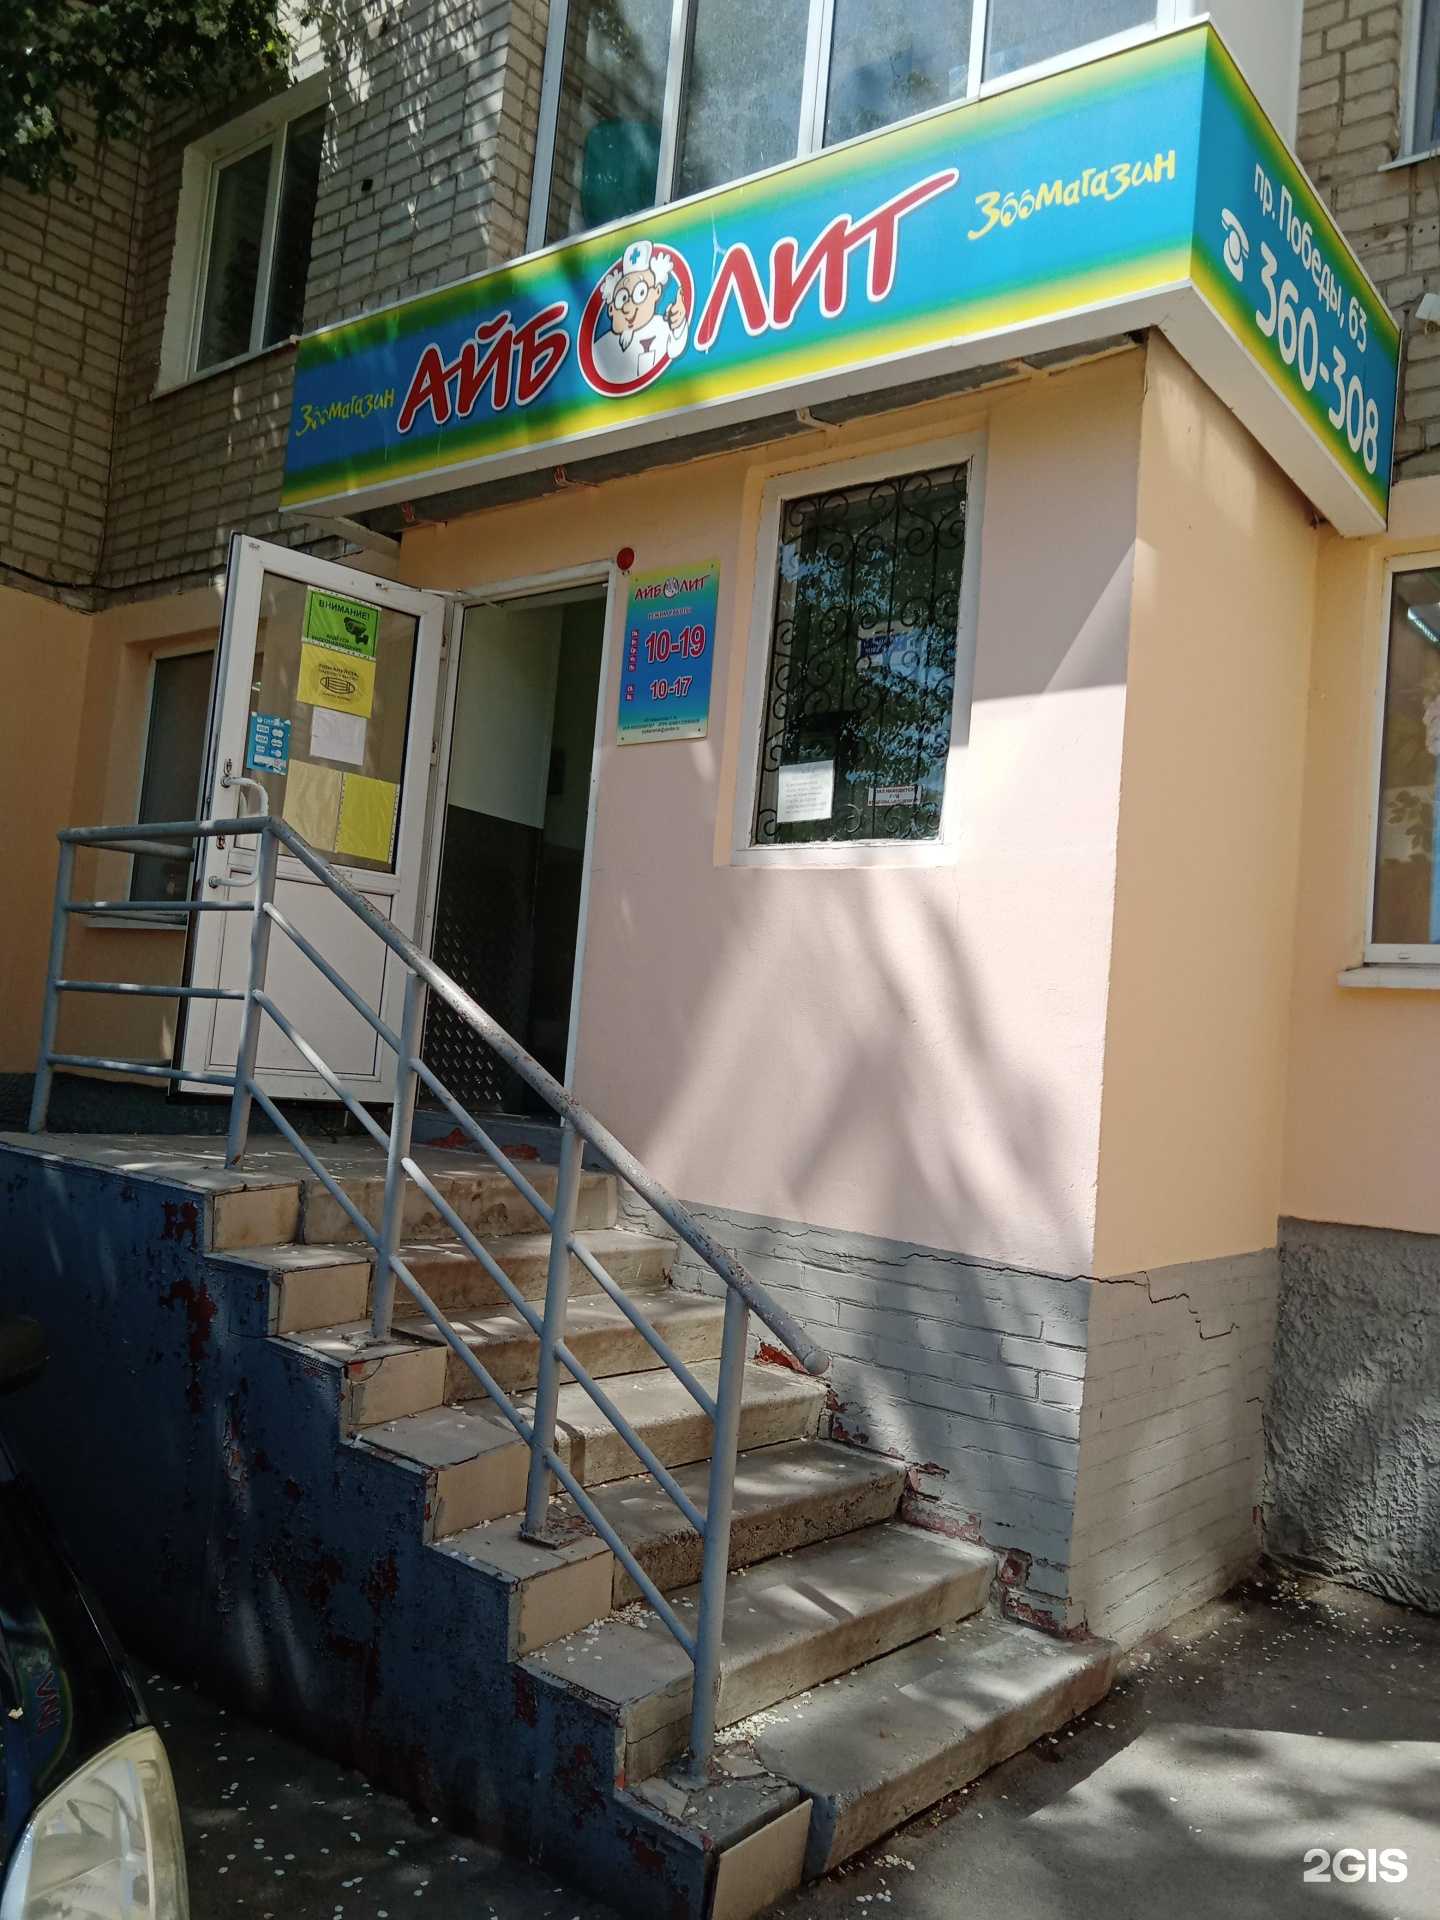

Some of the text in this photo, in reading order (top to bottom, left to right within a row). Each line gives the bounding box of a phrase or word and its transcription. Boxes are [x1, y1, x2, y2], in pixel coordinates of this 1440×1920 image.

[967, 149, 1176, 240] Зоомагазин
[1349, 296, 1368, 353] 63
[1255, 242, 1379, 474] 360-308
[296, 389, 395, 436] Зоомагазин
[645, 624, 706, 664] 10-19
[650, 676, 693, 700] 10-17
